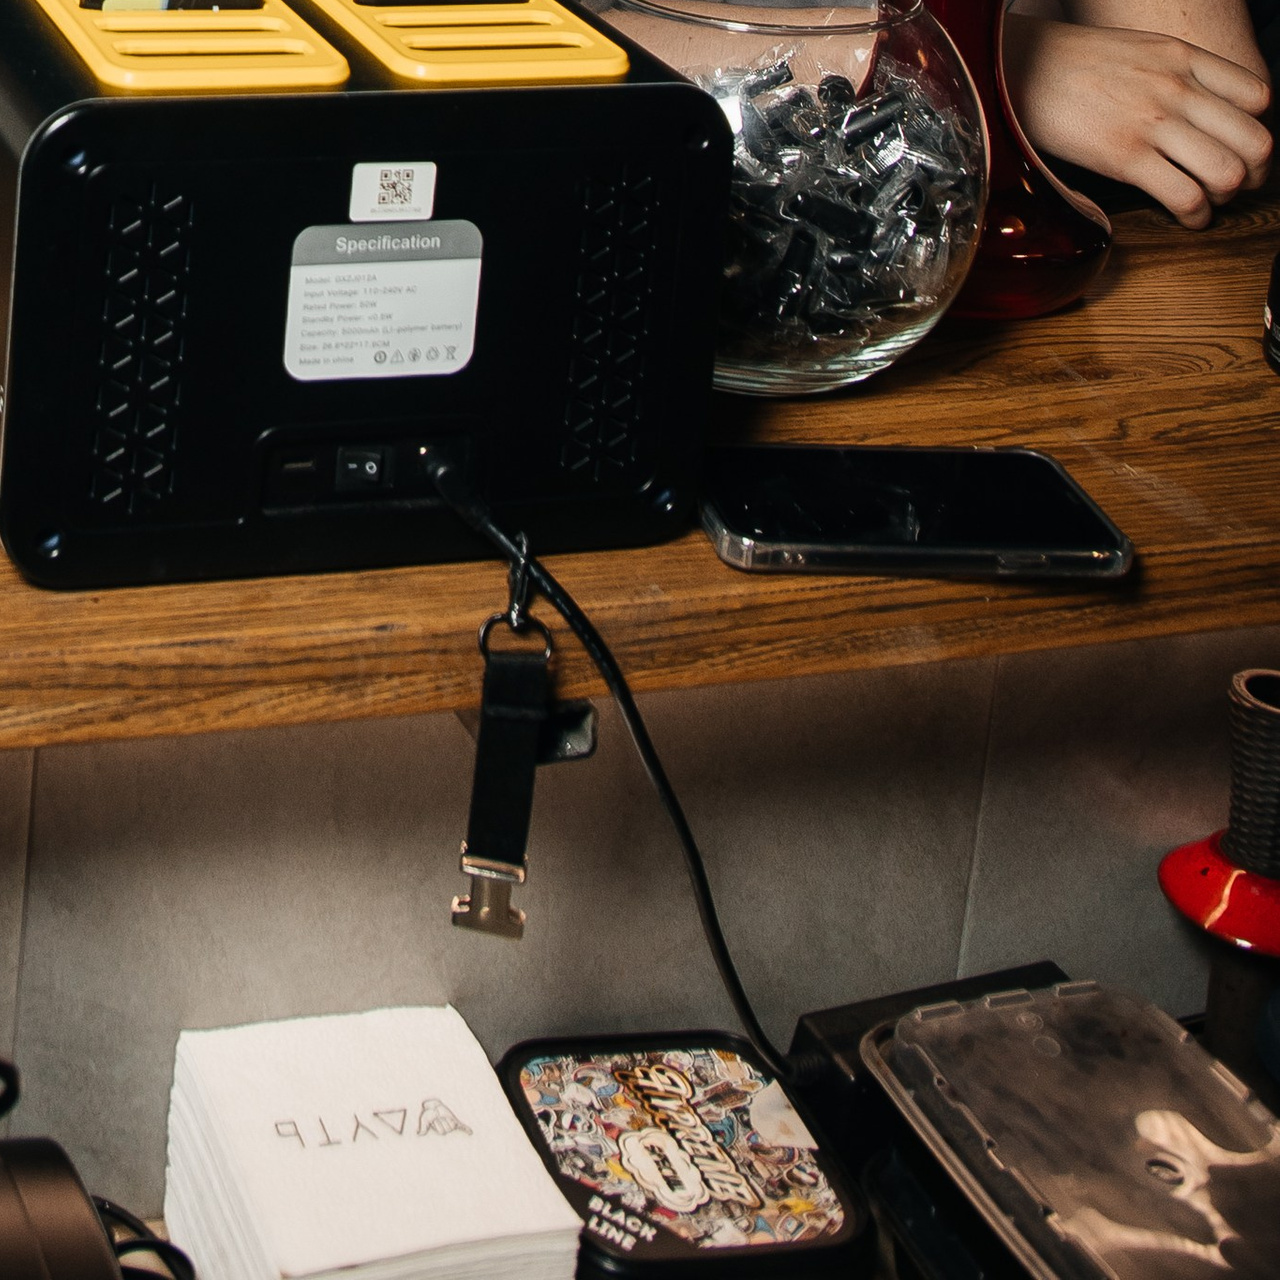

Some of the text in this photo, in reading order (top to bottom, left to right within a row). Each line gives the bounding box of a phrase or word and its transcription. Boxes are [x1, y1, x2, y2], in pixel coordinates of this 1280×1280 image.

[336, 234, 441, 254] Specification
[588, 1195, 657, 1241] BLACK
[588, 1215, 637, 1251] LINE
